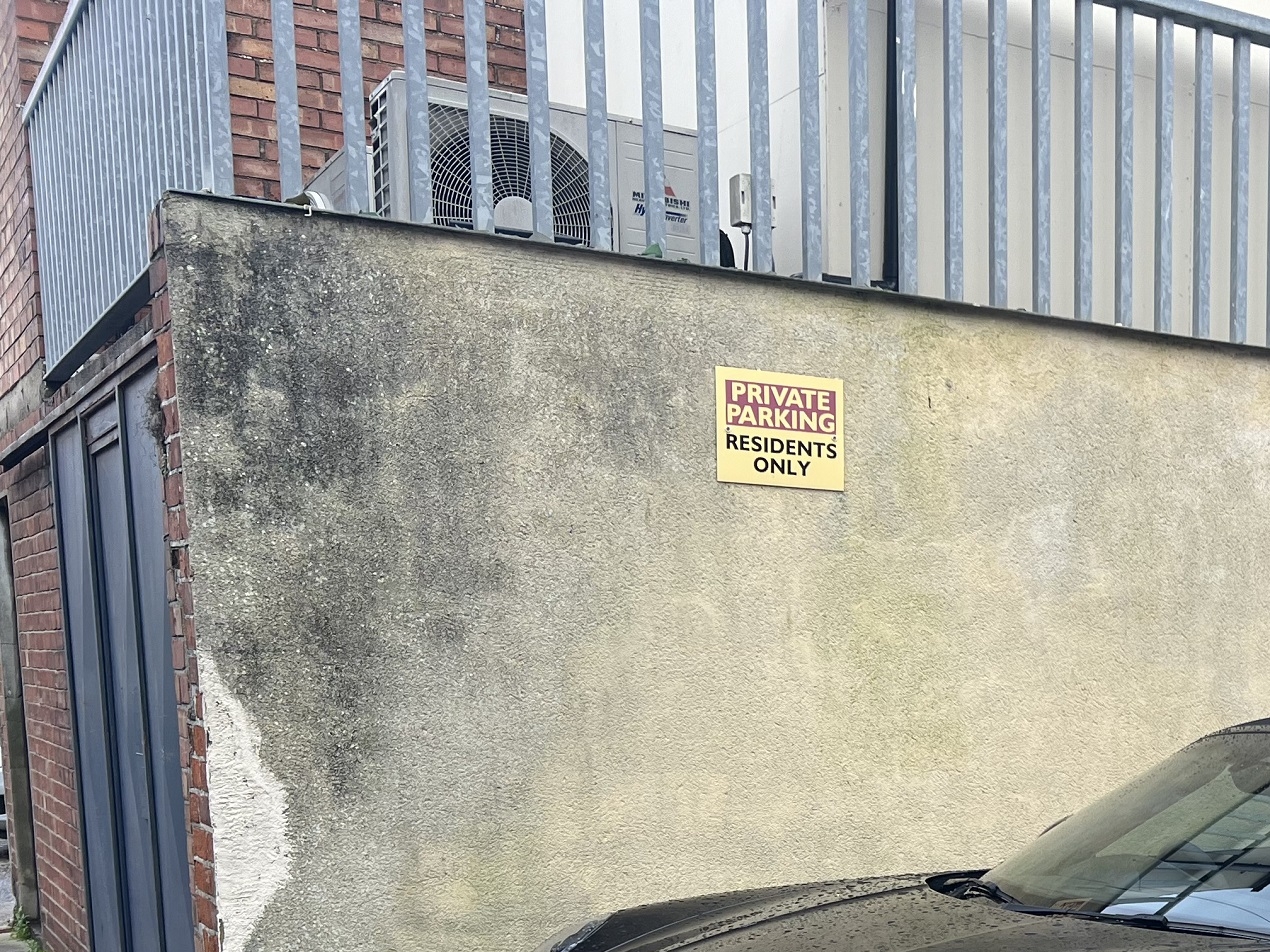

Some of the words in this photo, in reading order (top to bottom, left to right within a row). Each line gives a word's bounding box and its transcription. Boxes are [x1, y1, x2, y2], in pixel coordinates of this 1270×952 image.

[731, 382, 830, 411] PRIVATE
[727, 403, 835, 433] PARKING
[726, 433, 837, 459] RESIDENTS
[753, 457, 811, 476] ONLY
